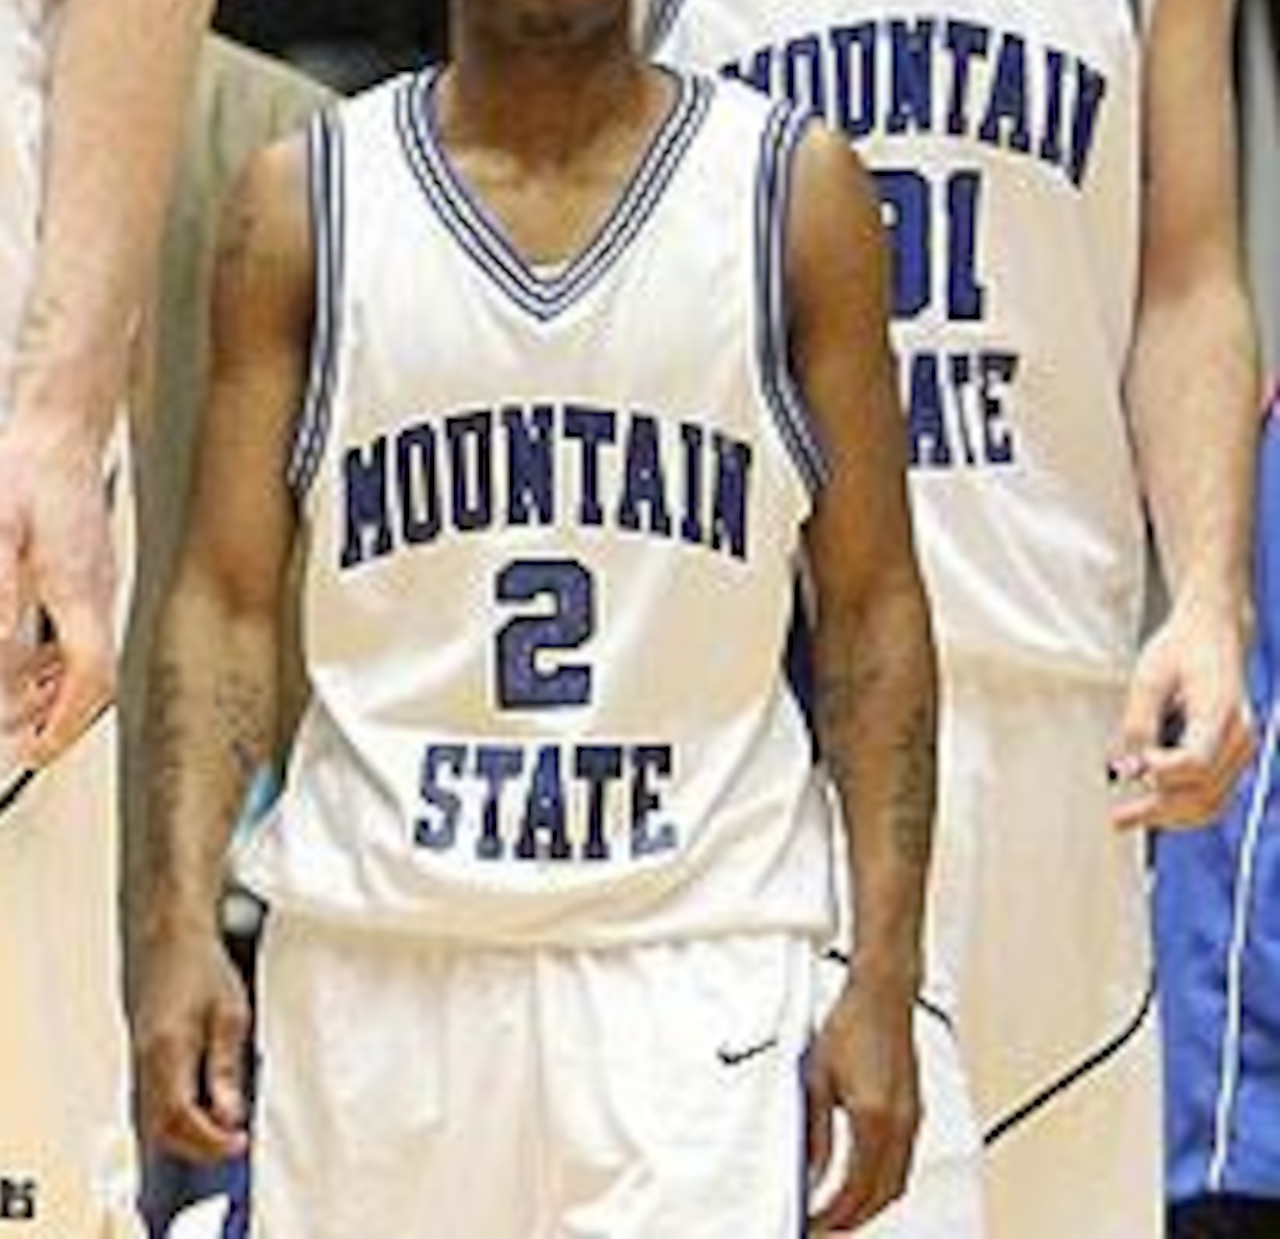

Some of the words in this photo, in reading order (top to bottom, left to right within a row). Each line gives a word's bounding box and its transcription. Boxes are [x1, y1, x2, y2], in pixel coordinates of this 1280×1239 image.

[906, 352, 1019, 468] ATE
[338, 405, 753, 569] MOUNTAIN
[494, 558, 595, 710] 2
[412, 744, 677, 860] STATE
